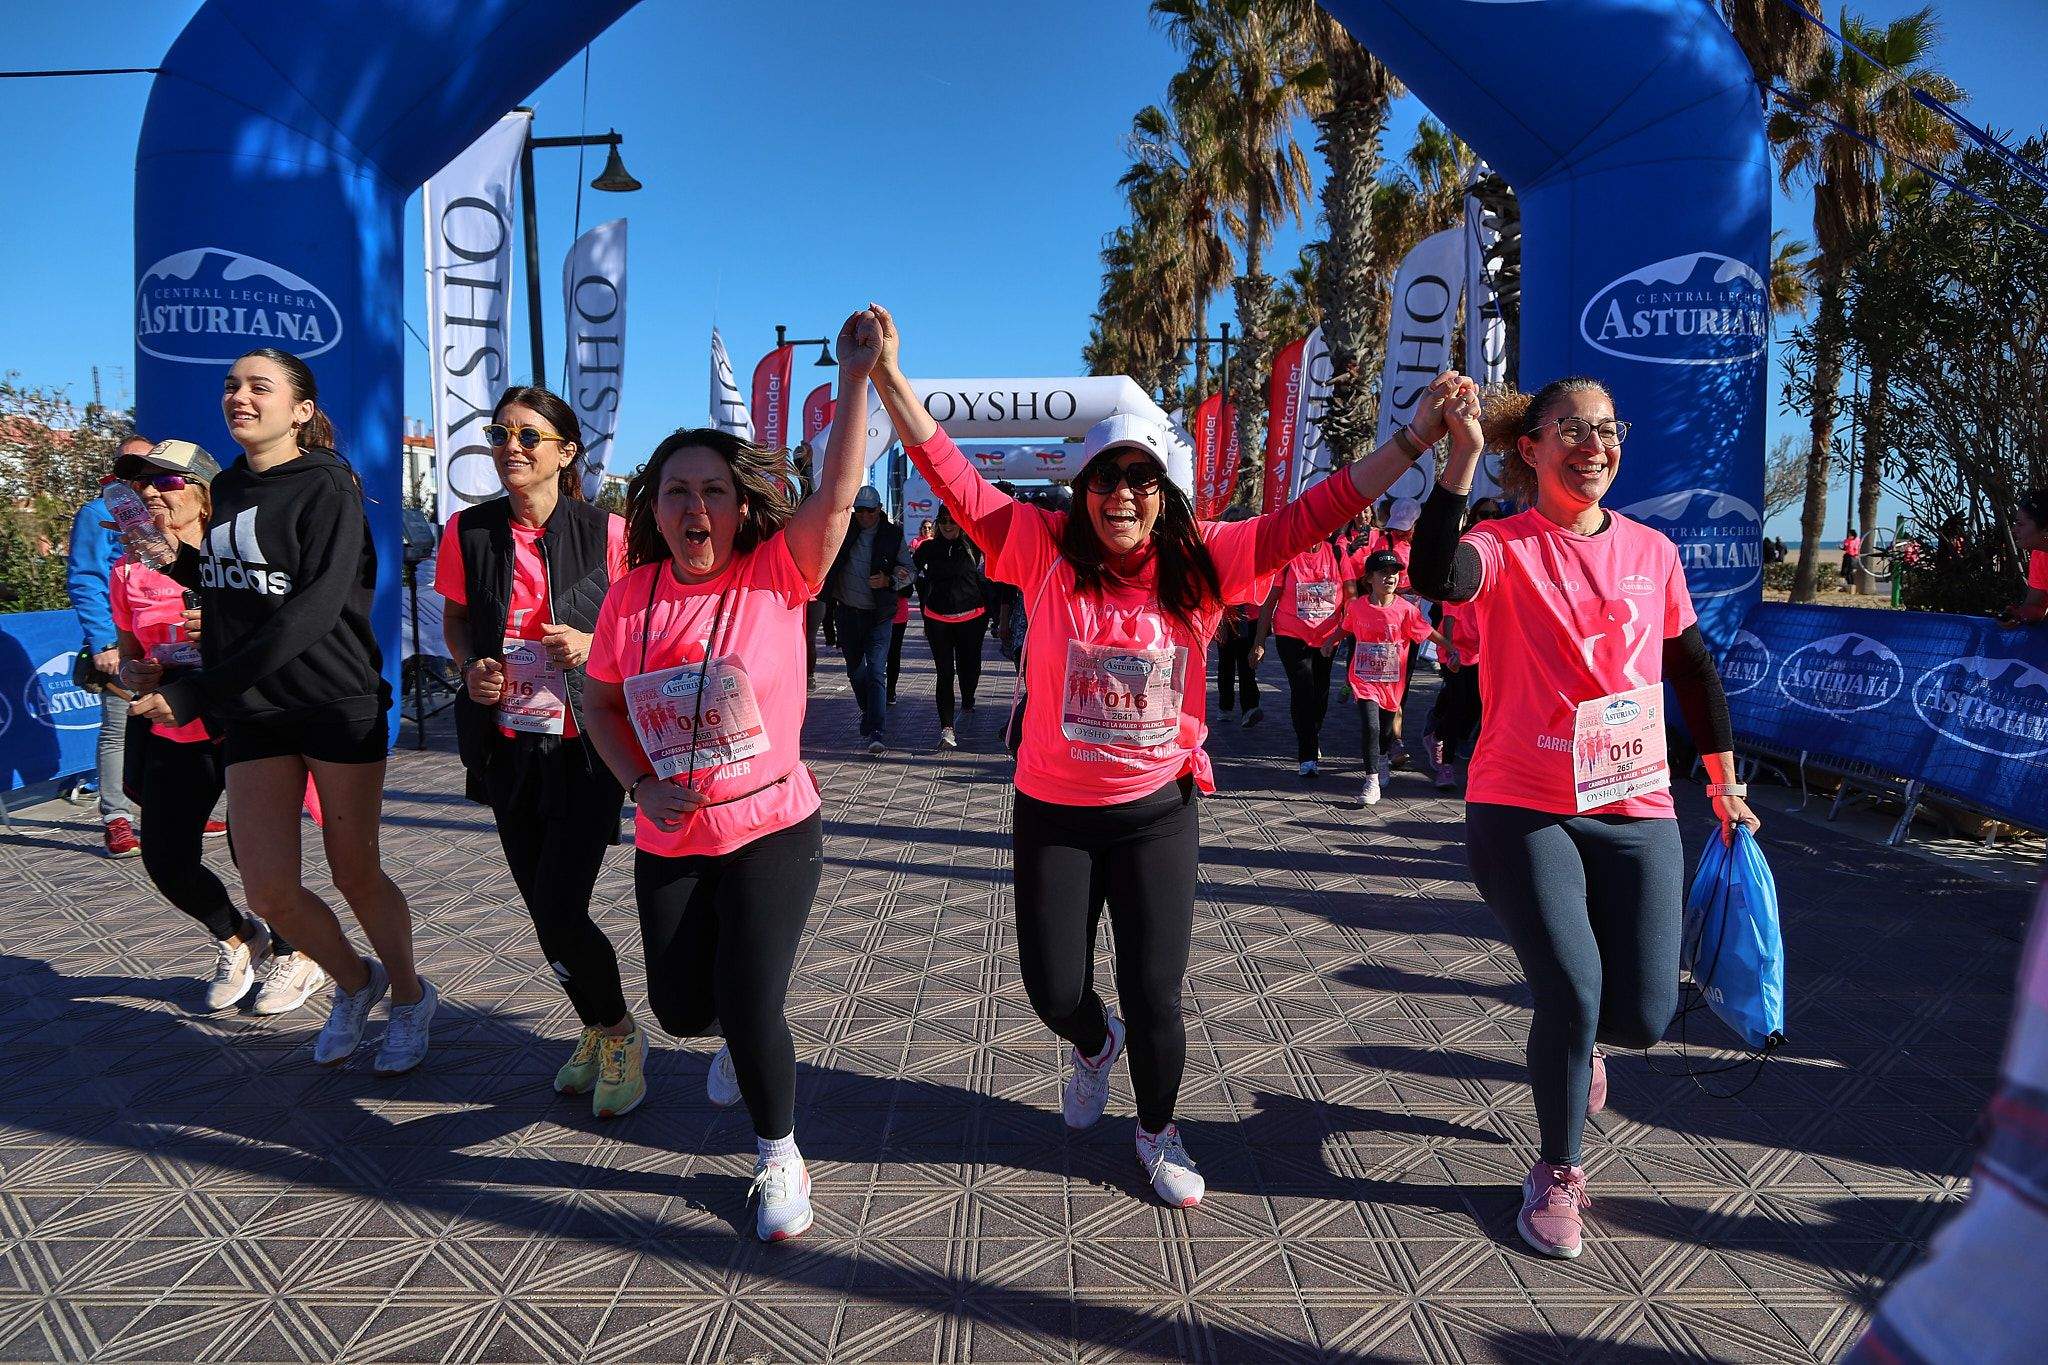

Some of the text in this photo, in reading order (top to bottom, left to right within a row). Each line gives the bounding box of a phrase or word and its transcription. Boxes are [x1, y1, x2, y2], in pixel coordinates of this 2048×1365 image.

[155, 287, 316, 309] CENTRAL LECHERA
[1636, 291, 1713, 304] CENTRAL
[137, 293, 325, 344] ASTURIANA
[441, 196, 505, 502] OYSHO
[574, 275, 619, 468] YSHO
[764, 373, 781, 451] antander
[923, 390, 1077, 422] OYSHO
[1278, 363, 1301, 457] Santander
[1204, 415, 1217, 482] Santander
[1668, 527, 1707, 537] TRAL
[1677, 542, 1761, 569] URIANA
[200, 556, 293, 596] didas
[1783, 658, 1890, 698] ASTURIANA
[38, 684, 102, 717] ASTURI
[1104, 691, 1148, 710] 016
[1920, 675, 2048, 741] ASTURIAN
[676, 708, 721, 731] 016
[1077, 717, 1102, 727] CARRERA
[1112, 712, 1133, 721] 2641
[1074, 727, 1111, 740] OYSHO
[1610, 738, 1643, 762] 016
[1616, 761, 1634, 773] 2657
[1587, 787, 1617, 803] OYSHO
